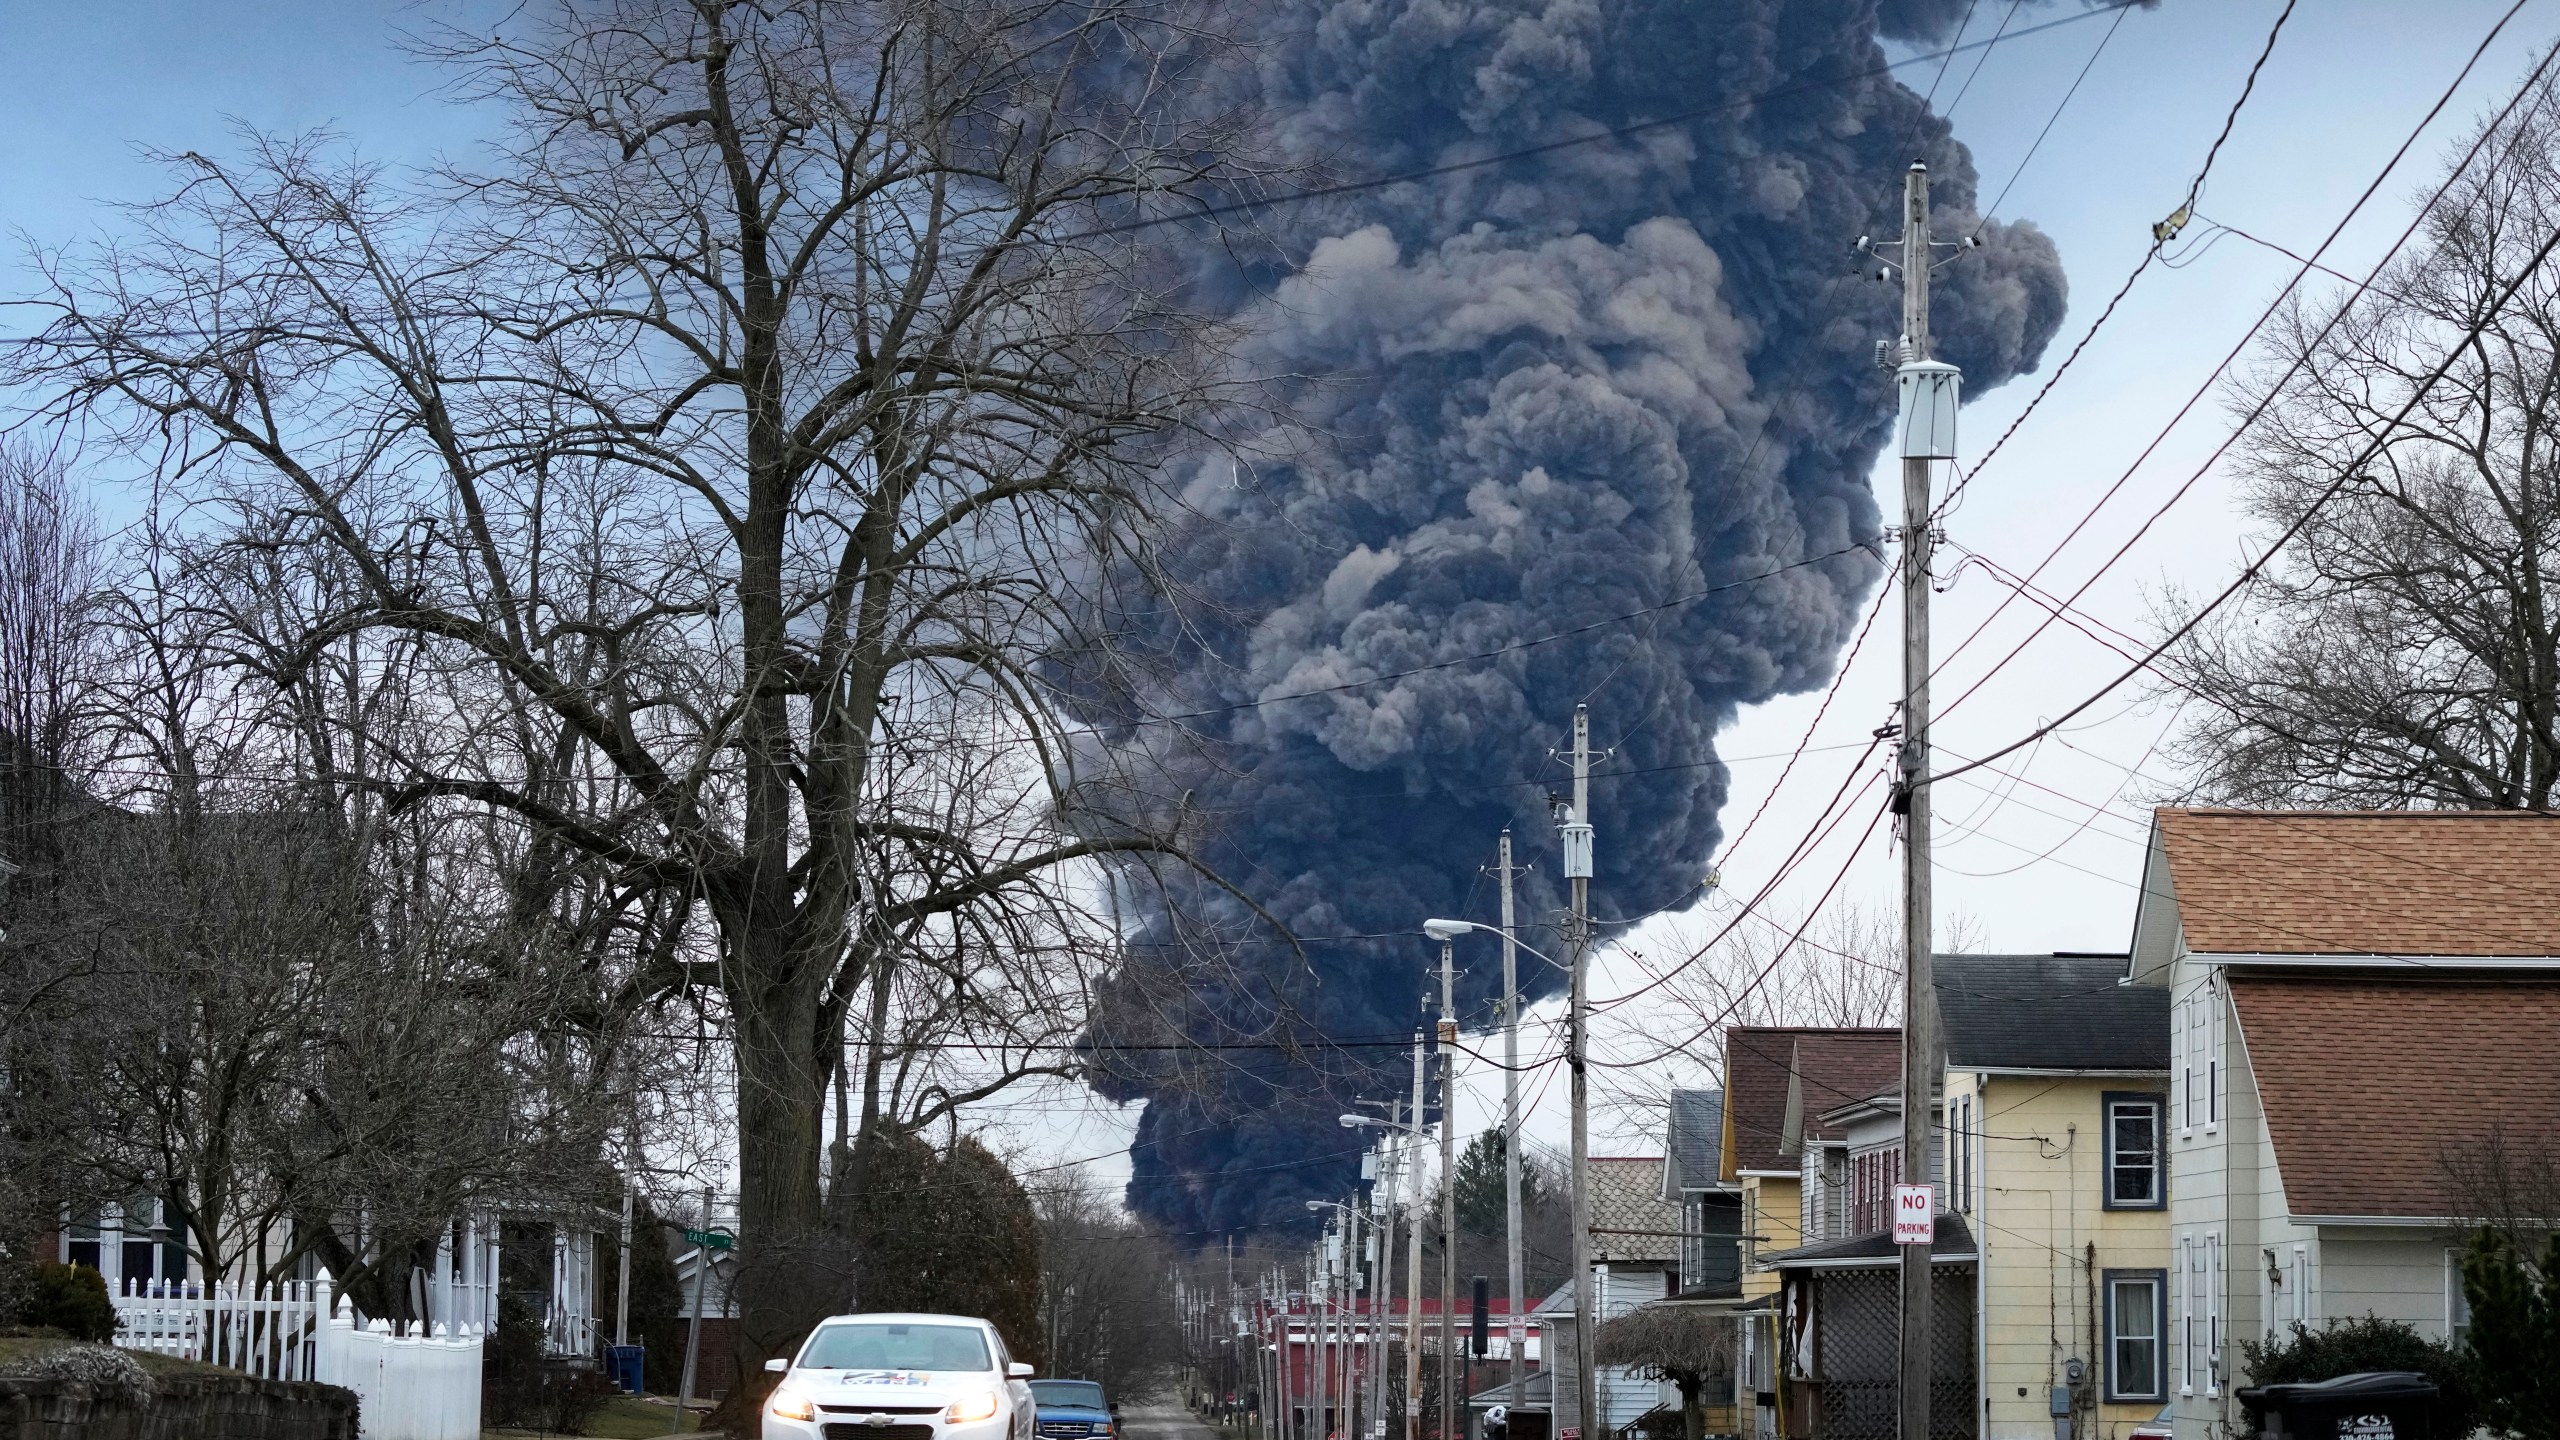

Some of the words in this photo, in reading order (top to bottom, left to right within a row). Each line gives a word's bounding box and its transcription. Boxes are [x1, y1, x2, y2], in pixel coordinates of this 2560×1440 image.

[1903, 1195, 1925, 1209] NO
[1897, 1223, 1930, 1235] PARKING
[688, 1231, 708, 1243] EAST
